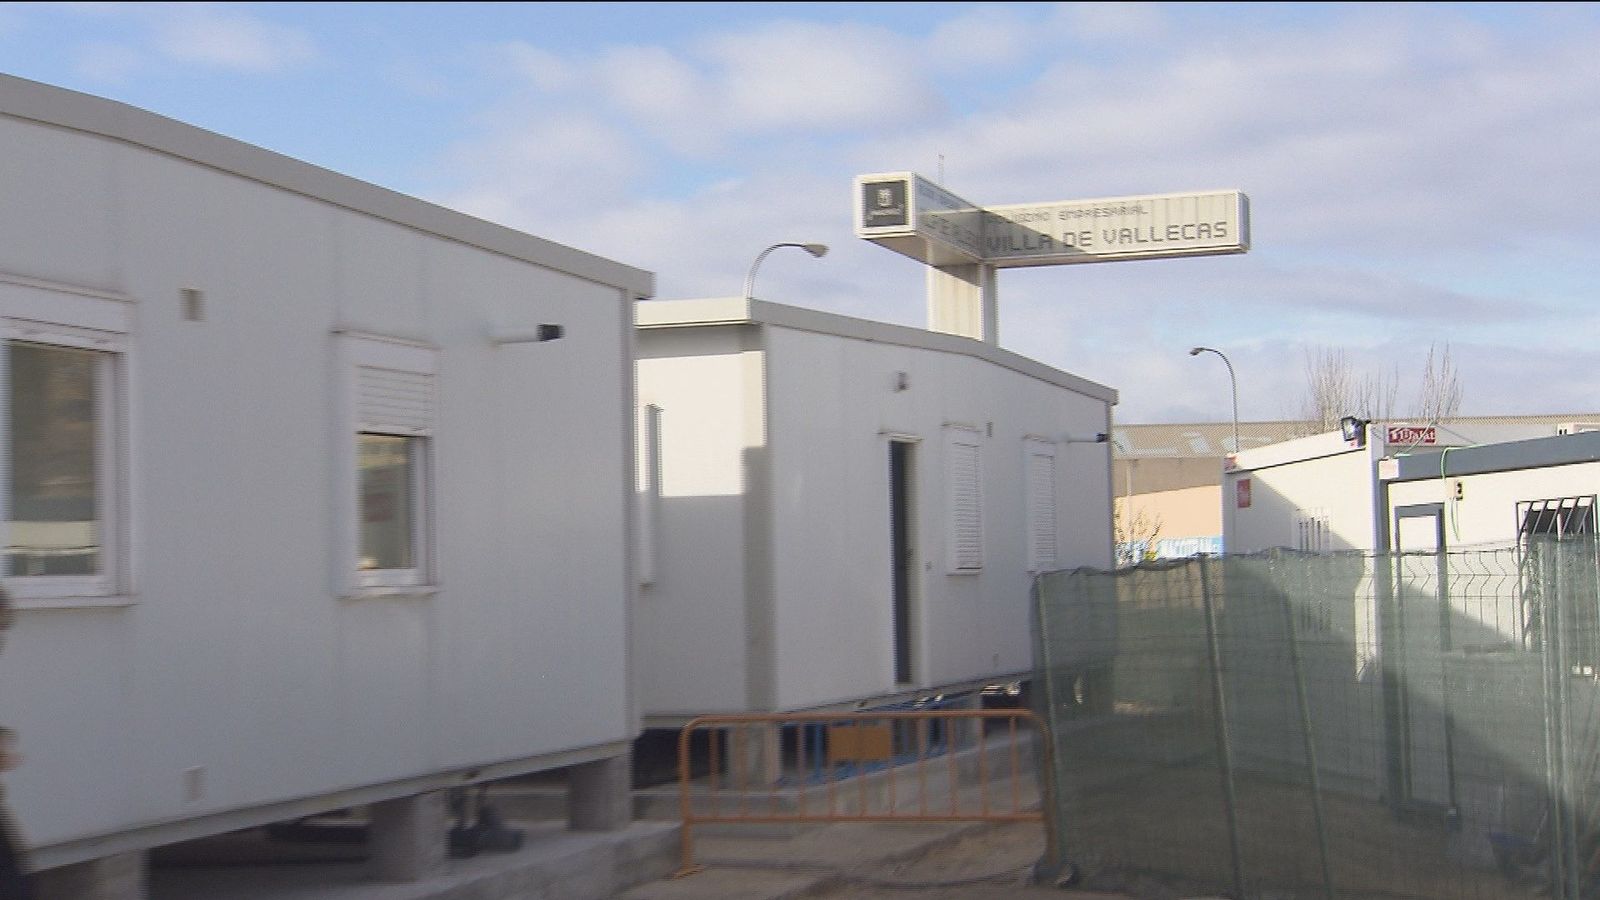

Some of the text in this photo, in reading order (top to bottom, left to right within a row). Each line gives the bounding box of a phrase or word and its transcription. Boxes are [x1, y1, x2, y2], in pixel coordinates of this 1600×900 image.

[986, 233, 1053, 251] VILLA
[1062, 231, 1092, 248] DE
[1102, 221, 1228, 244] VALLECAS
